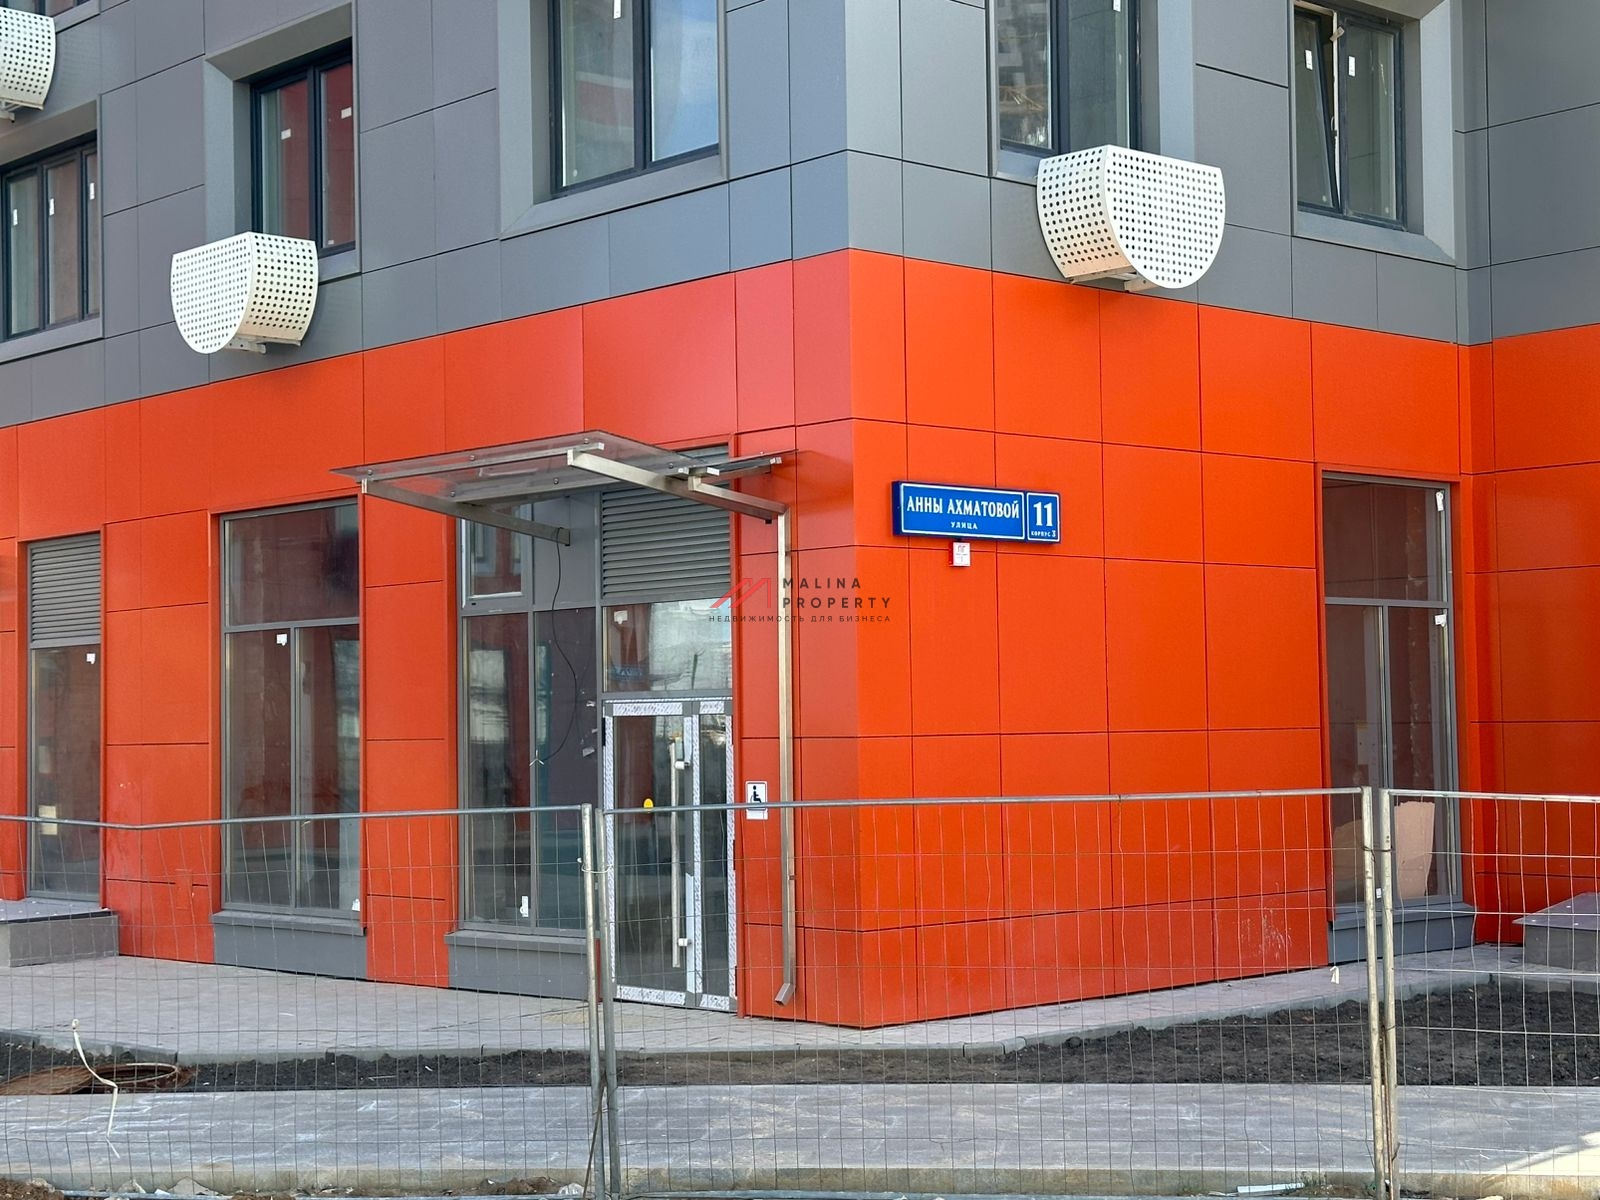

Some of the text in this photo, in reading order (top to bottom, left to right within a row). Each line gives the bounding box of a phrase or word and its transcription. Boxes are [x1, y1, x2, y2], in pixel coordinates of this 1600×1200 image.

[907, 496, 1019, 518] АННЫ АХМАТОВОЙ
[1033, 501, 1053, 526] 11
[950, 521, 978, 530] УЛИЦА
